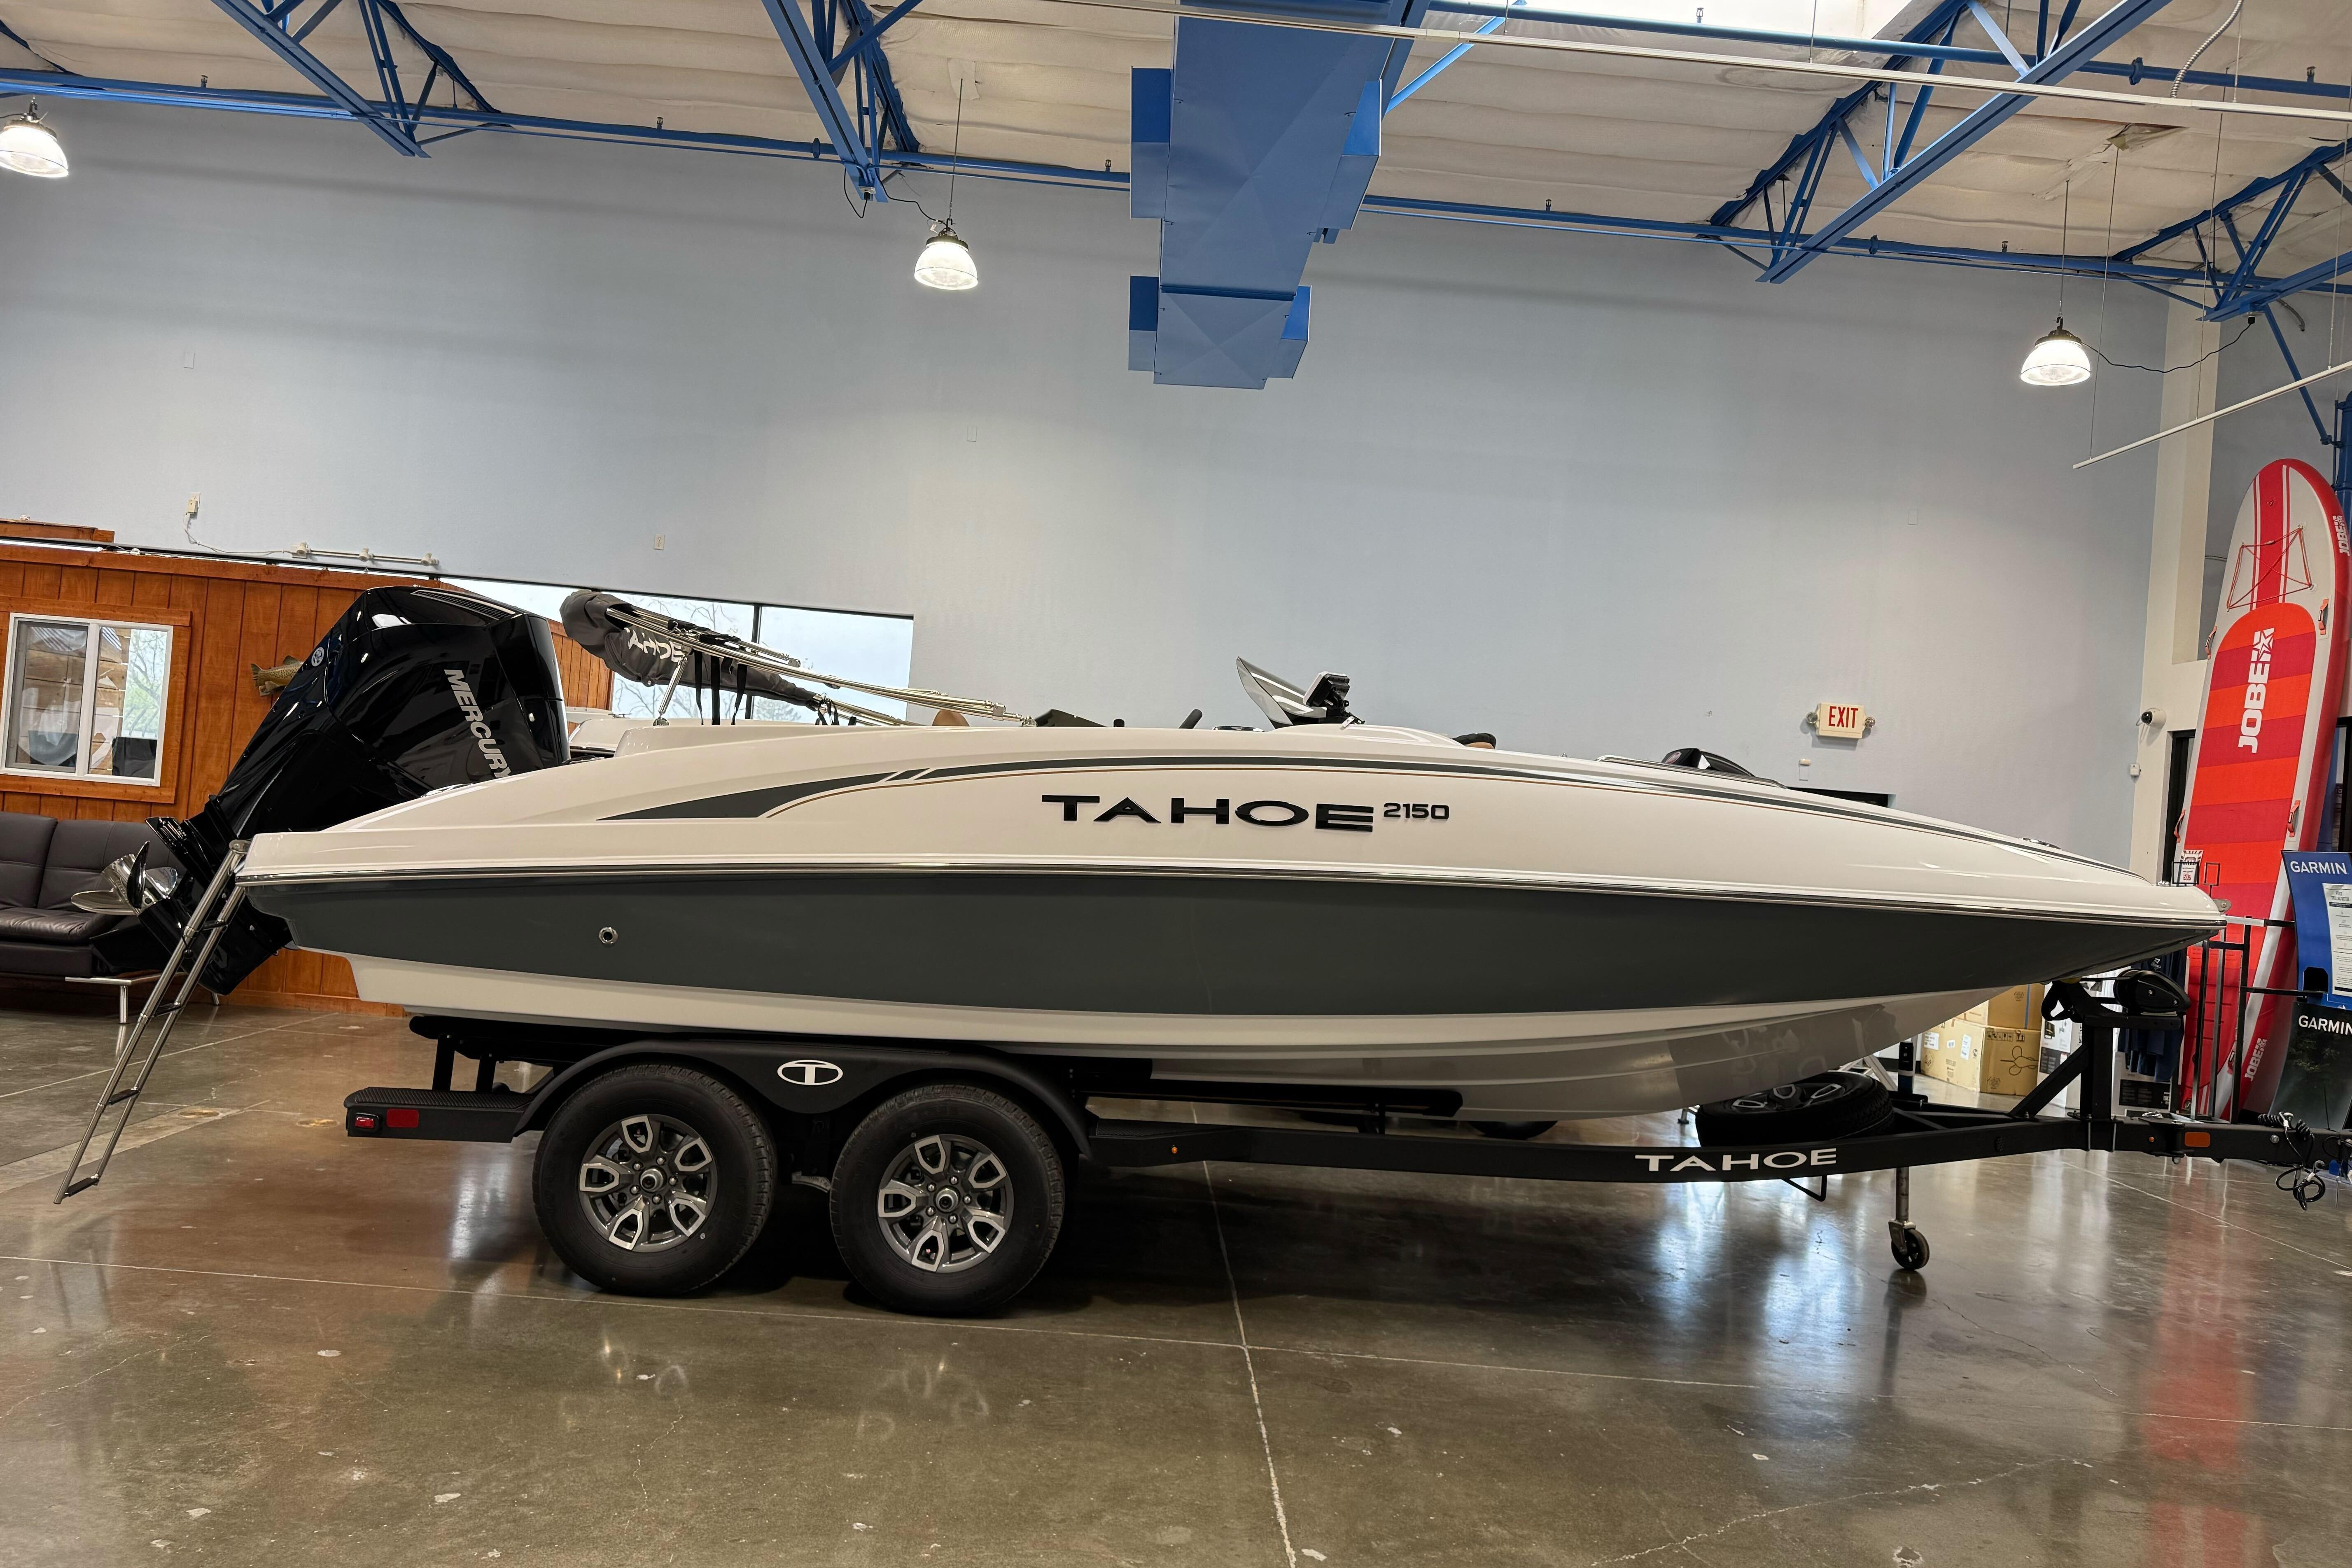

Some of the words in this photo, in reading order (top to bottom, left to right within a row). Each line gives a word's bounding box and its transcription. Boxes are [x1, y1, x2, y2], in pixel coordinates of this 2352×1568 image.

[2335, 525, 2350, 556] JOBE
[444, 669, 511, 778] MERCURY
[1828, 706, 1859, 728] EXIT
[2238, 663, 2270, 753] JOBE
[1041, 795, 1374, 832] TAHOE
[1384, 803, 1449, 819] 2150
[2290, 861, 2347, 875] GARMIN
[2245, 1048, 2264, 1082] JOBE
[1635, 1148, 1836, 1171] TAHOE
